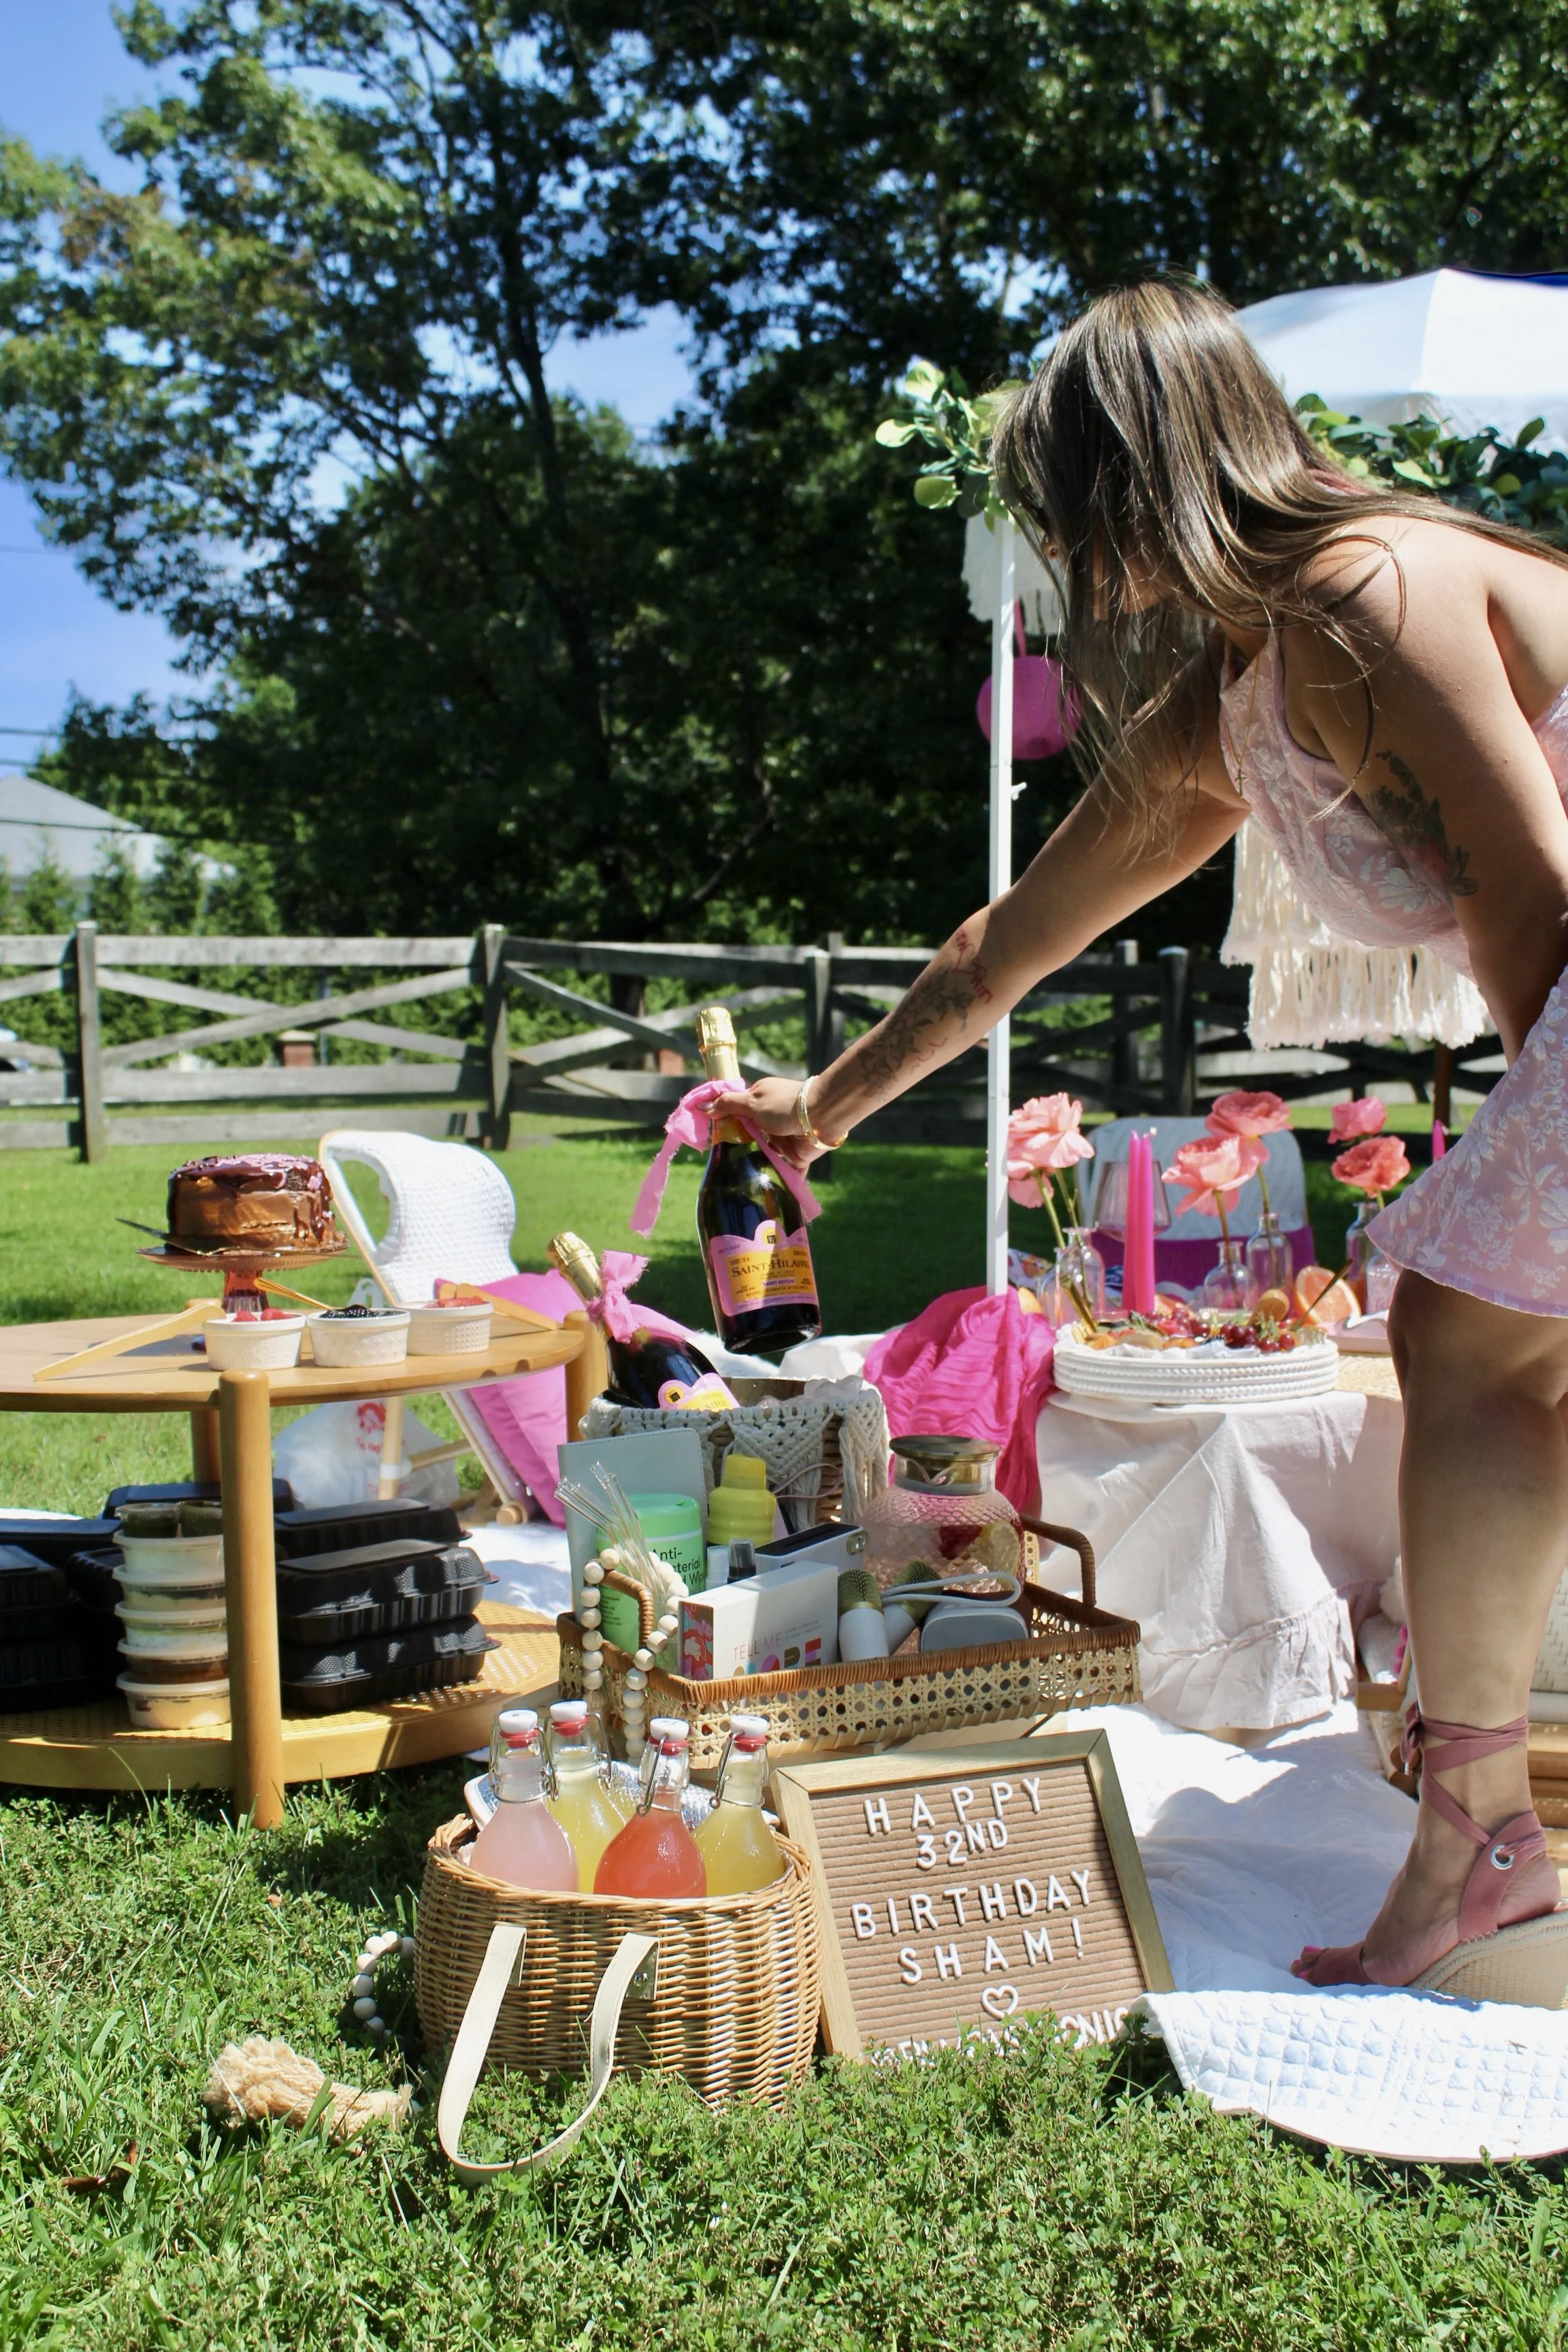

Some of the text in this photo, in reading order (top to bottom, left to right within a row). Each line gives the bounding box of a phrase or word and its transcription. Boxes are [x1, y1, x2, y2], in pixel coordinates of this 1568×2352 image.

[732, 1258, 810, 1277] SAINT-HILAIRE
[733, 1632, 782, 1662] TELL ME
[863, 1776, 1041, 1835] HAPPY
[915, 1818, 1009, 1870] 32ND
[850, 1868, 1091, 1940] BIRTHDAY
